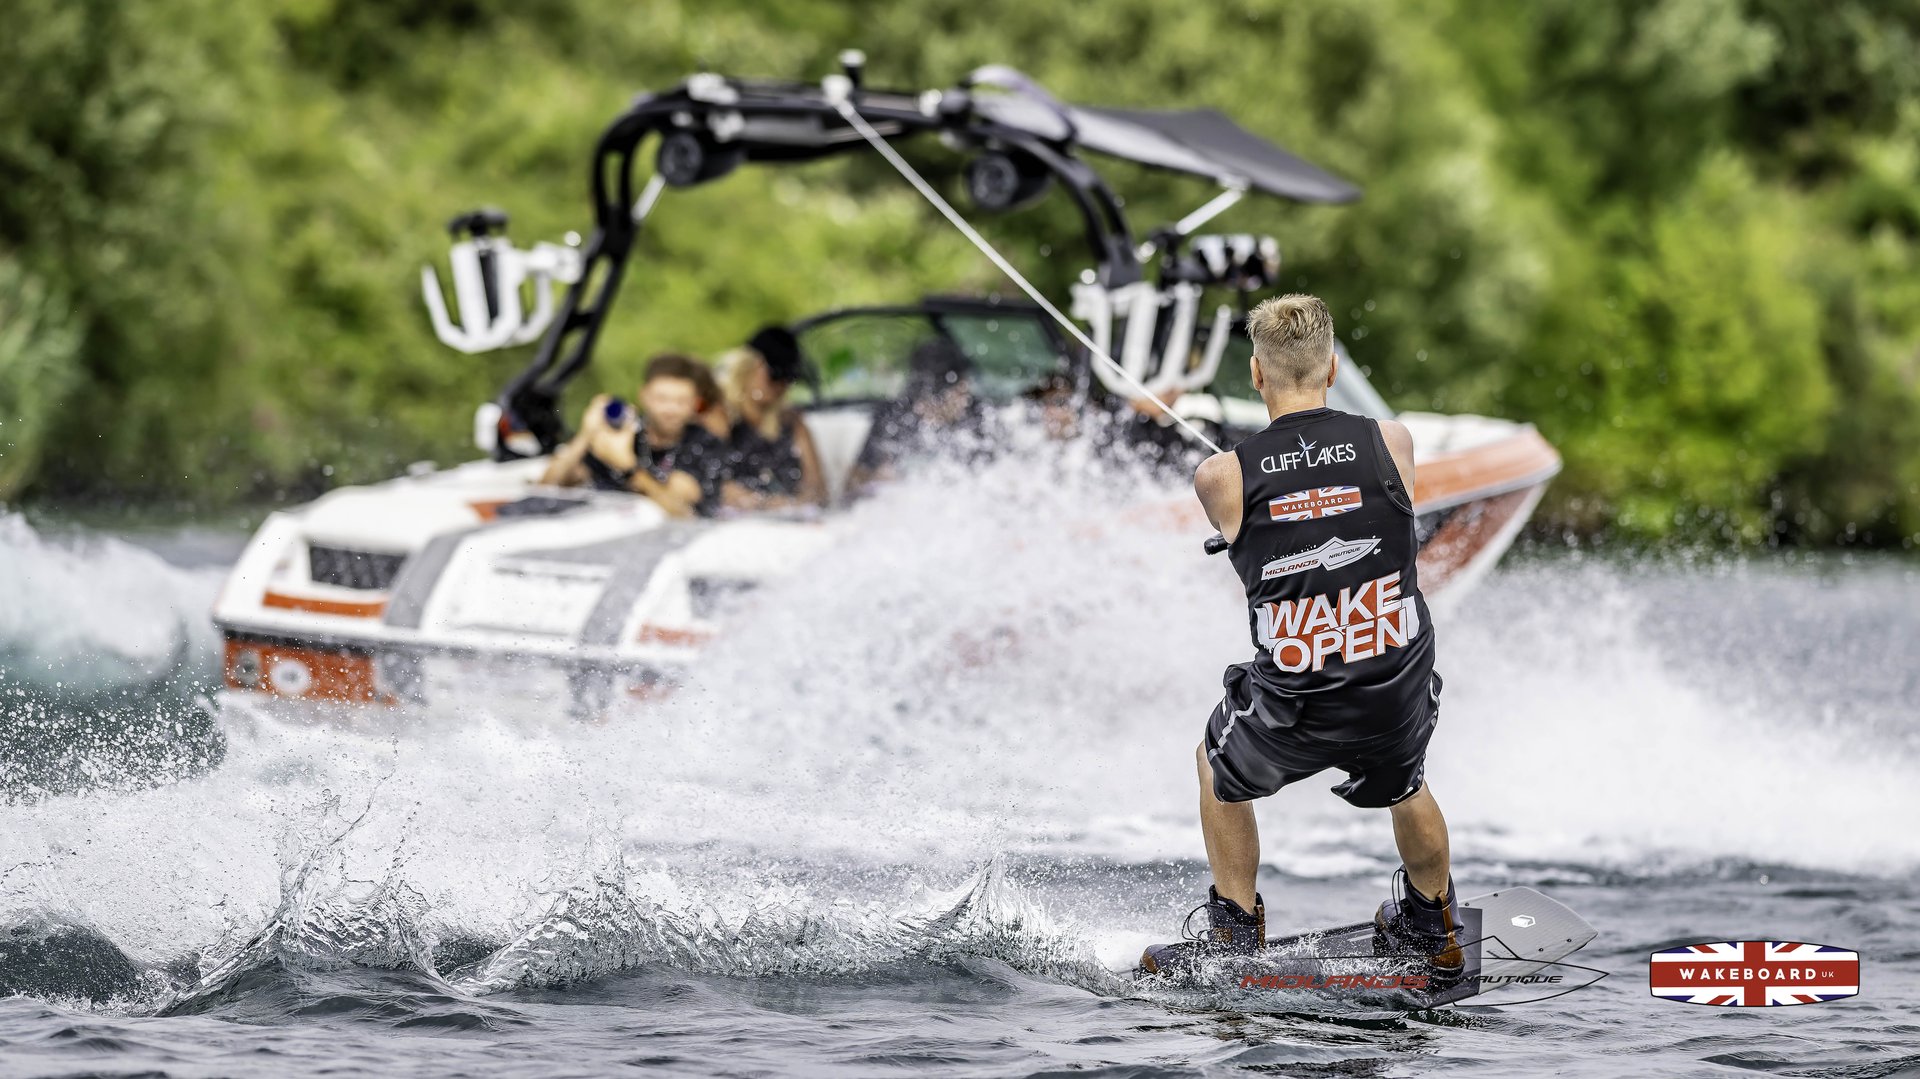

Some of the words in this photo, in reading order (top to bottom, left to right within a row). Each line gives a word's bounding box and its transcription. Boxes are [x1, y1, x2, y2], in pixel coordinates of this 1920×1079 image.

[1261, 452, 1302, 473] CLIFF
[1305, 443, 1356, 468] LAKES
[1282, 497, 1343, 512] WAKEBOARD
[1328, 546, 1361, 559] NAUTIQUE
[1264, 558, 1319, 576] MIDLANDS
[1263, 570, 1402, 638] WAKE
[1272, 607, 1408, 674] OPEN
